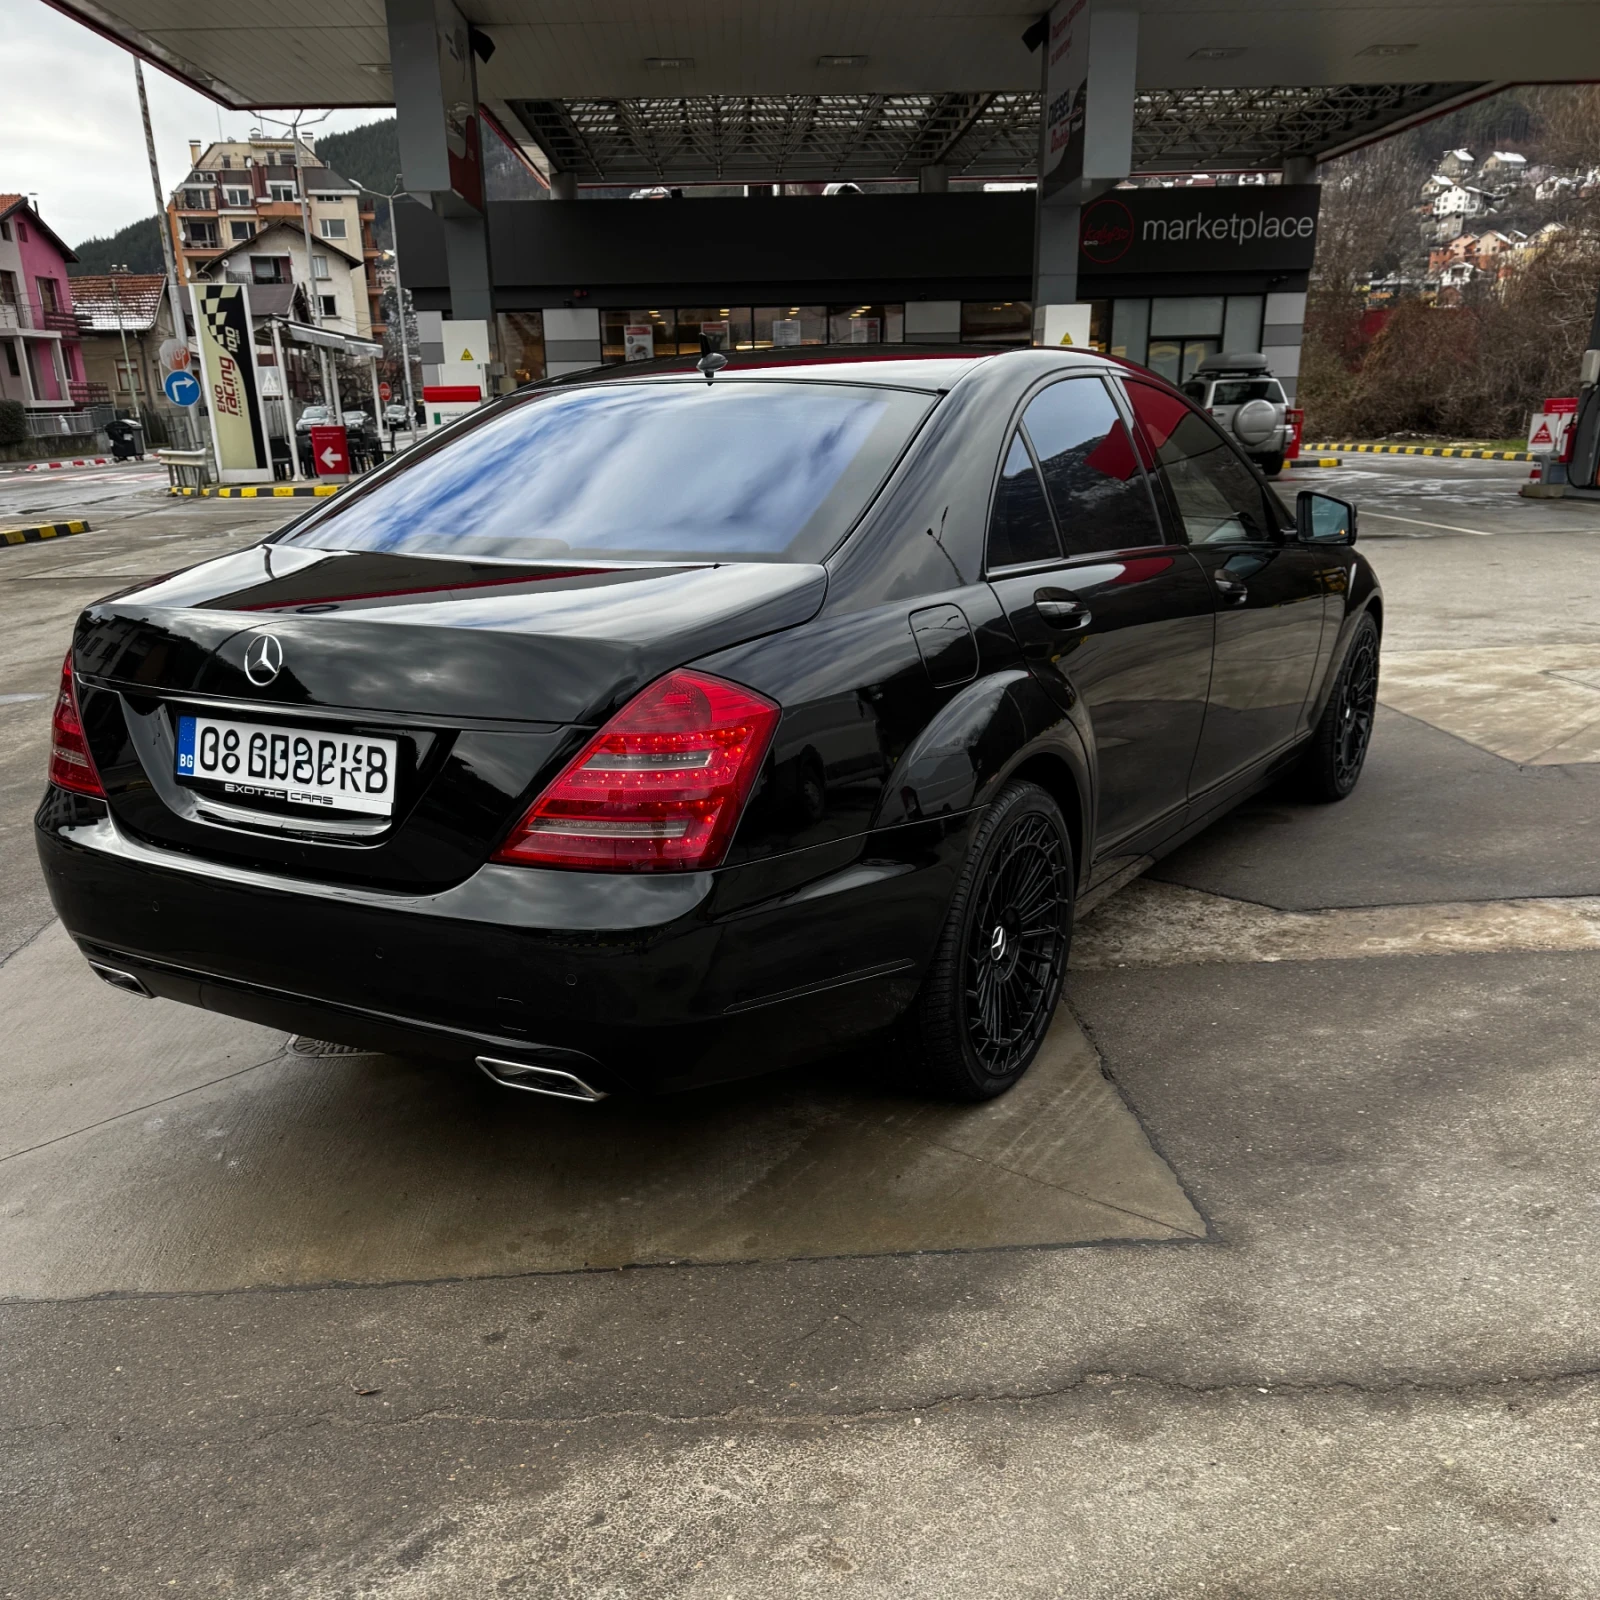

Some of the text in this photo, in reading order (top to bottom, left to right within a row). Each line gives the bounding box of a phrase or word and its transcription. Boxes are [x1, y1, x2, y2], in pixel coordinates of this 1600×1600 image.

[1143, 211, 1313, 245] marketplace
[225, 326, 238, 352] 100
[214, 384, 226, 413] EKO
[219, 356, 238, 416] racing
[180, 753, 193, 768] BG
[224, 783, 333, 806] EXOTIC CARS
